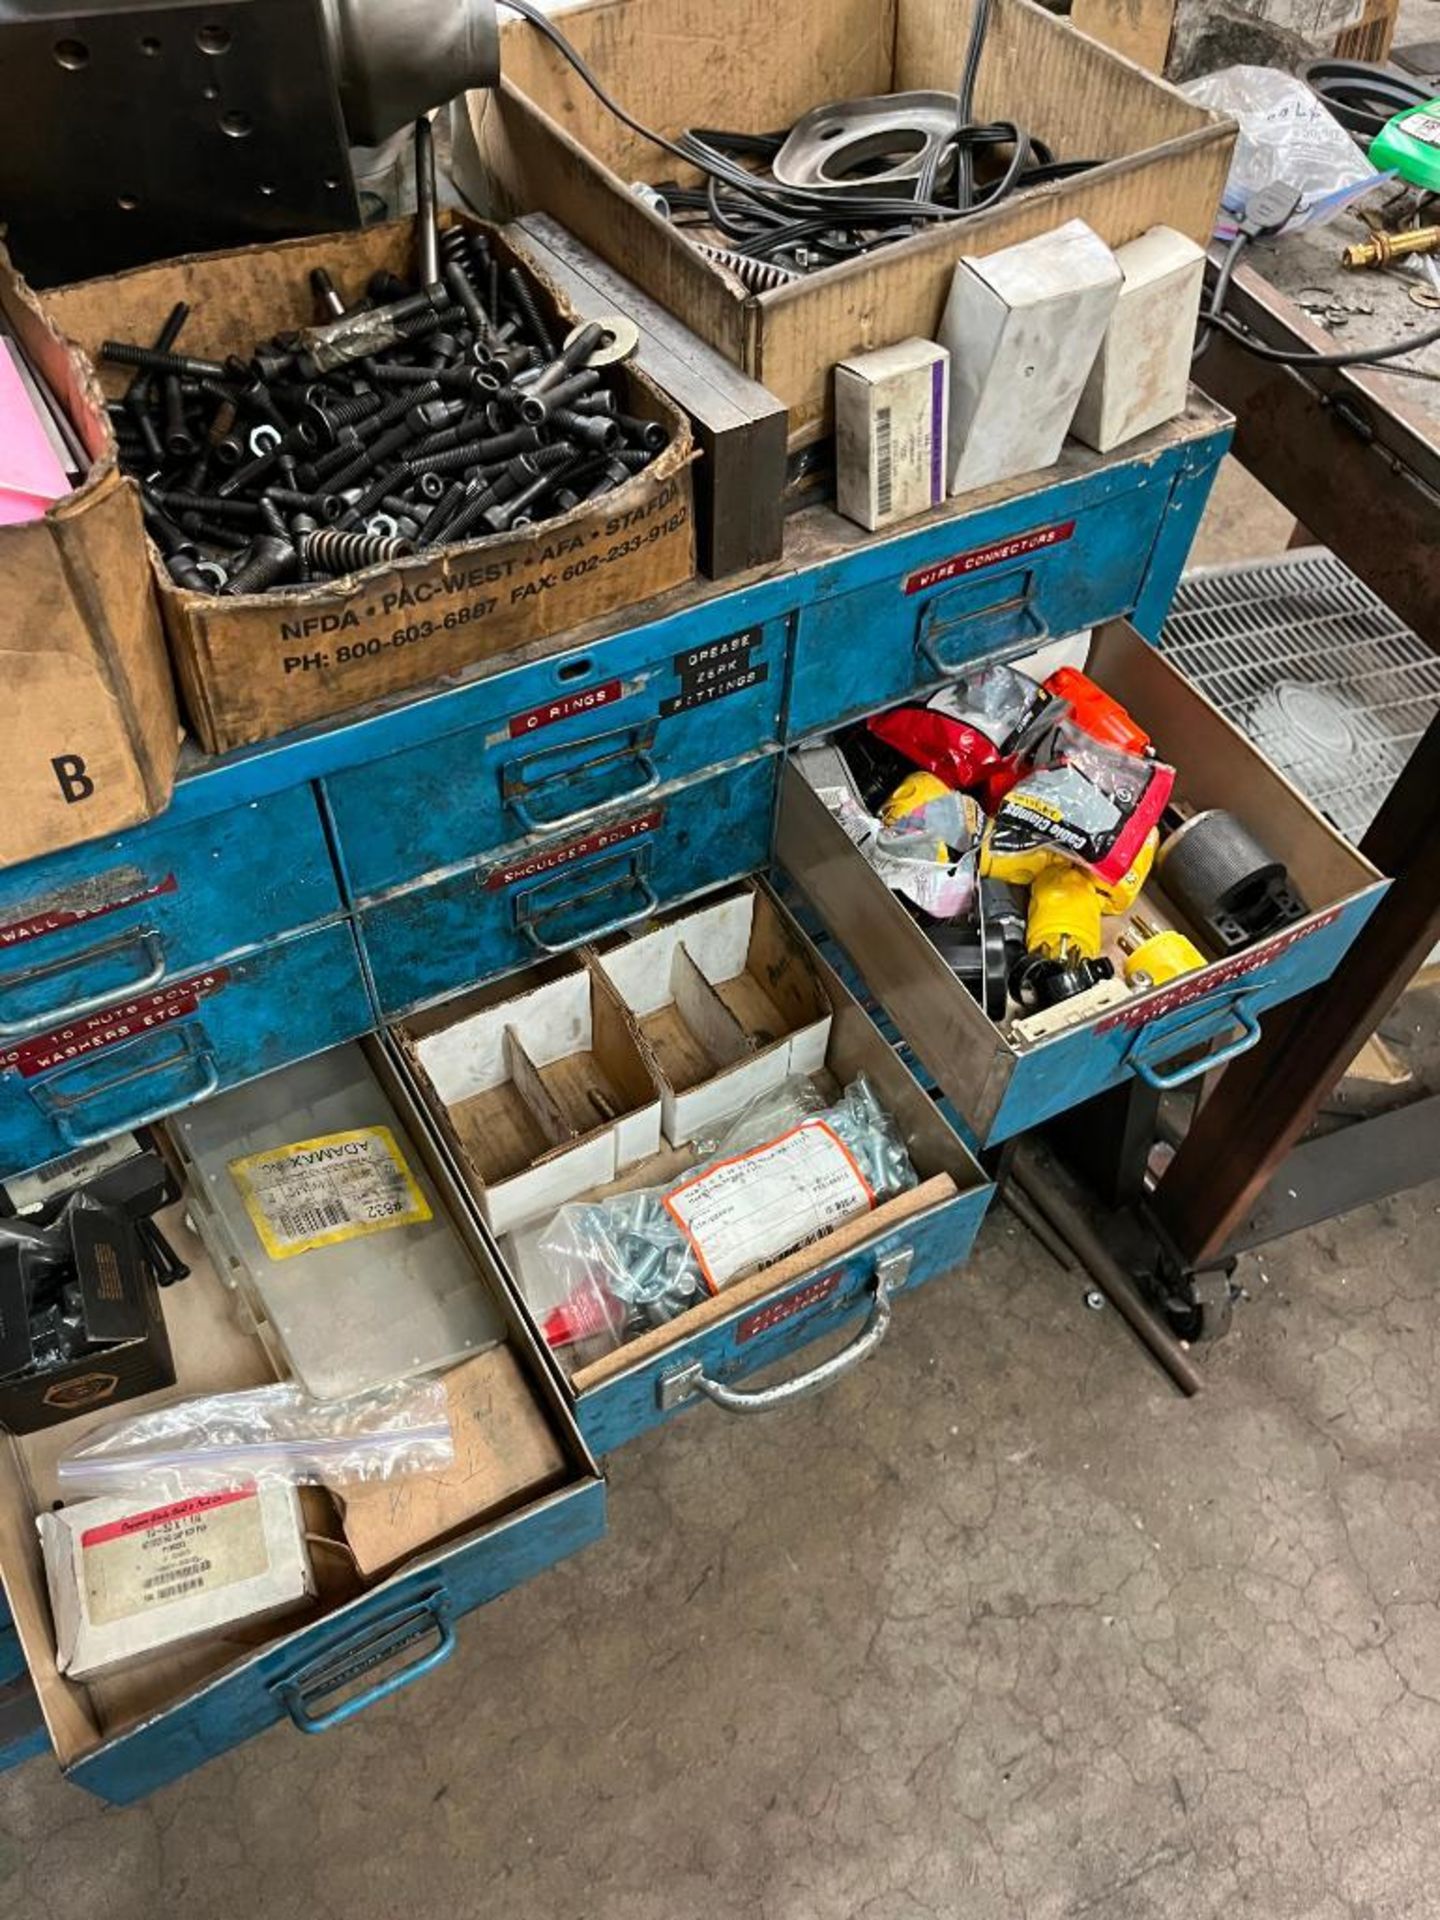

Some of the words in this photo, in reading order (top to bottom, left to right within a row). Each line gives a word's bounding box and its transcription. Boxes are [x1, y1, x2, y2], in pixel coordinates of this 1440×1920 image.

[281, 609, 360, 641] NFDA
[383, 559, 517, 615] PAC-WEST
[539, 536, 585, 565] AFA
[605, 480, 679, 536] STAFDA
[920, 563, 955, 586] WIRE
[964, 531, 1056, 570] CONNECTORS
[284, 651, 330, 674] PH:
[336, 597, 498, 664] 800-603-6887
[510, 573, 558, 604] FAX:
[561, 507, 688, 582] 602-233-9182
[688, 633, 750, 666] GREASE
[527, 716, 538, 728] O
[549, 690, 607, 719] RINGS
[673, 671, 756, 710] FITTINGS
[50, 754, 94, 804] B
[503, 843, 588, 884] SHOULDER
[598, 821, 650, 847] BOLTS
[1, 919, 59, 942] WALL
[87, 1005, 139, 1029] NUTS
[152, 976, 215, 1005] BOLTS
[37, 1025, 131, 1067] WASHERS
[143, 1005, 181, 1026] ETC
